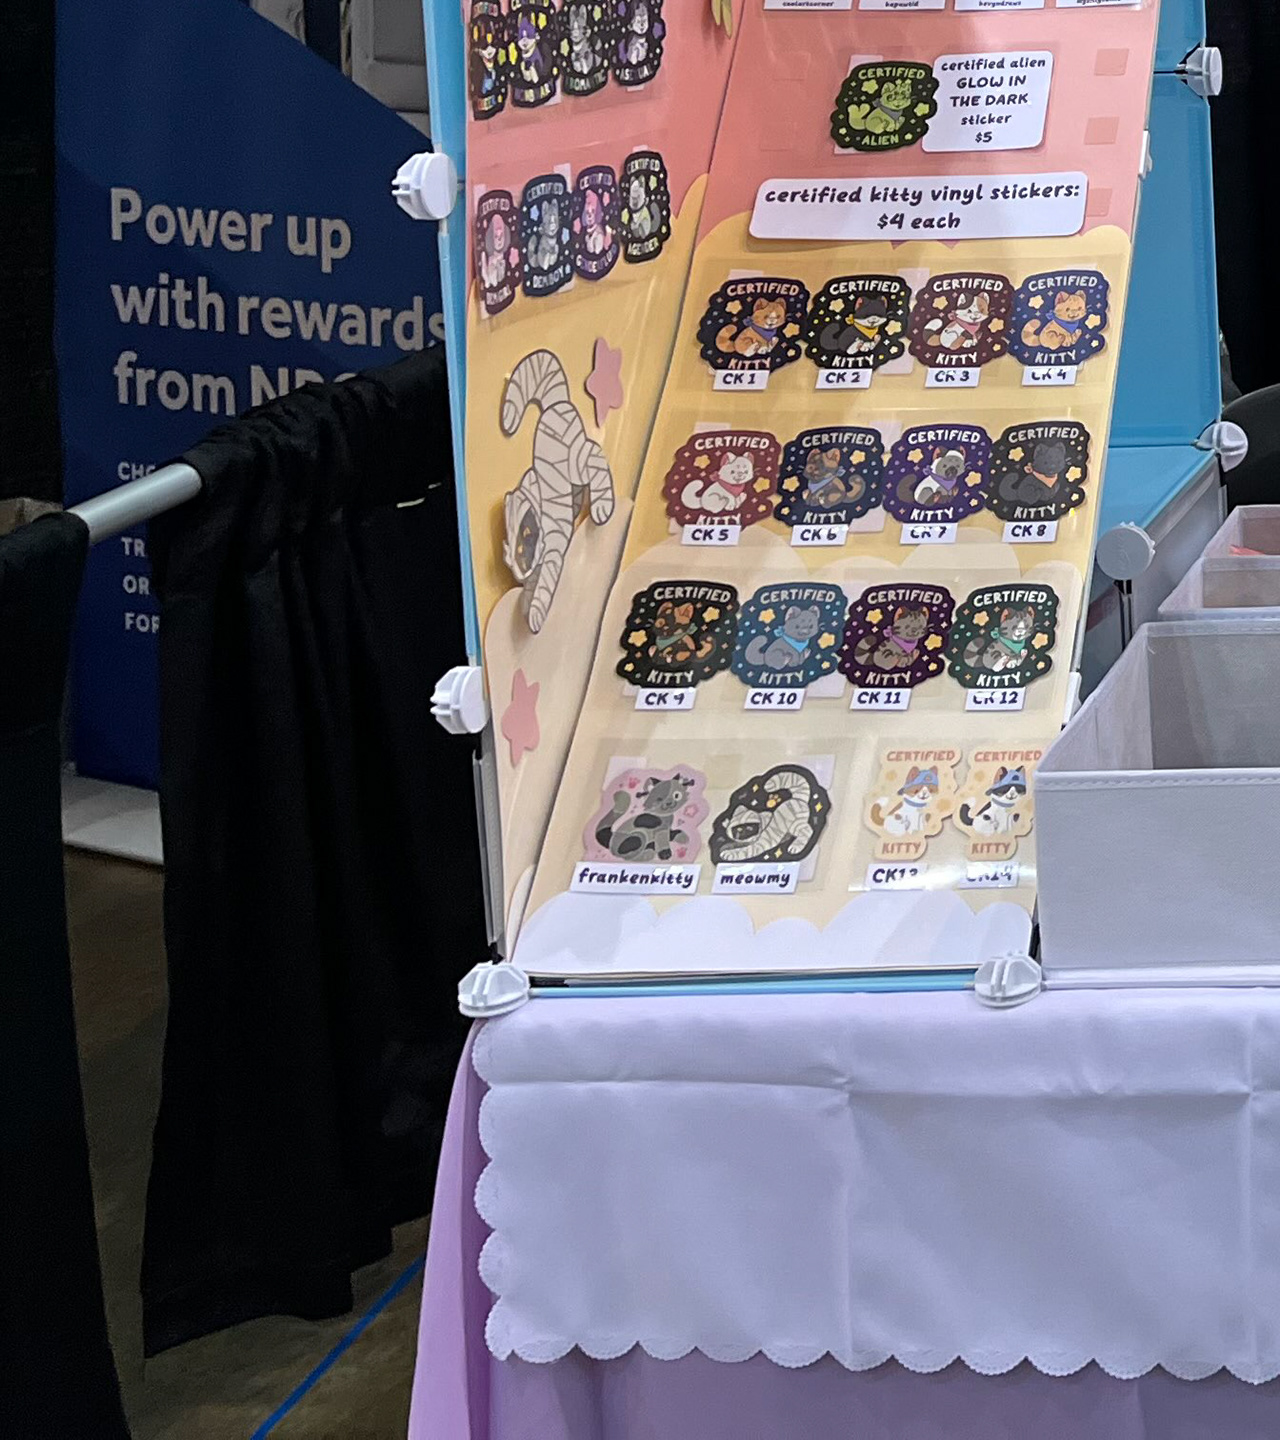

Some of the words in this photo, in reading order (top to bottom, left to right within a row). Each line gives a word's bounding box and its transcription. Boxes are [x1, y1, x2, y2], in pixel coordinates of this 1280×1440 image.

[940, 57, 1005, 72] certified
[1009, 56, 1046, 69] alien
[858, 66, 926, 80] CERTIFIED
[956, 75, 1004, 90] GLOW
[1008, 74, 1027, 87] IN
[949, 95, 982, 108] THE
[984, 92, 1029, 107] DARK
[960, 112, 1012, 126] sticker
[861, 133, 899, 146] ALIEN
[974, 131, 993, 144] $5
[765, 185, 863, 204] certified
[869, 185, 923, 207] kitty
[930, 183, 984, 206] vinyl
[989, 182, 1080, 200] stickers:
[876, 212, 905, 230] $4
[910, 211, 961, 230] each
[111, 187, 272, 251] Power
[287, 215, 352, 273] up
[726, 282, 800, 297] CERTIFIED
[829, 280, 901, 295] CERTIFIED
[932, 277, 1004, 293] CERTIFIED
[1028, 275, 1098, 292] CERTIFIED
[111, 273, 225, 332] with
[114, 351, 236, 416] from
[722, 372, 745, 385] CK
[746, 371, 756, 384] 1
[825, 371, 848, 384] CK
[850, 371, 861, 383] 2
[694, 435, 770, 451] CERTIFIED
[1008, 426, 1080, 444] CERTIFIED
[1013, 502, 1056, 519] KITTY
[691, 528, 715, 542] CK
[717, 528, 730, 542] 5
[1010, 524, 1033, 538] CK
[1036, 524, 1047, 537] 8
[750, 691, 775, 705] CK
[776, 692, 798, 705] 10
[857, 691, 881, 705] CK
[883, 691, 901, 705] 11
[578, 867, 694, 889] frankenkitty
[720, 873, 791, 889] meowmy
